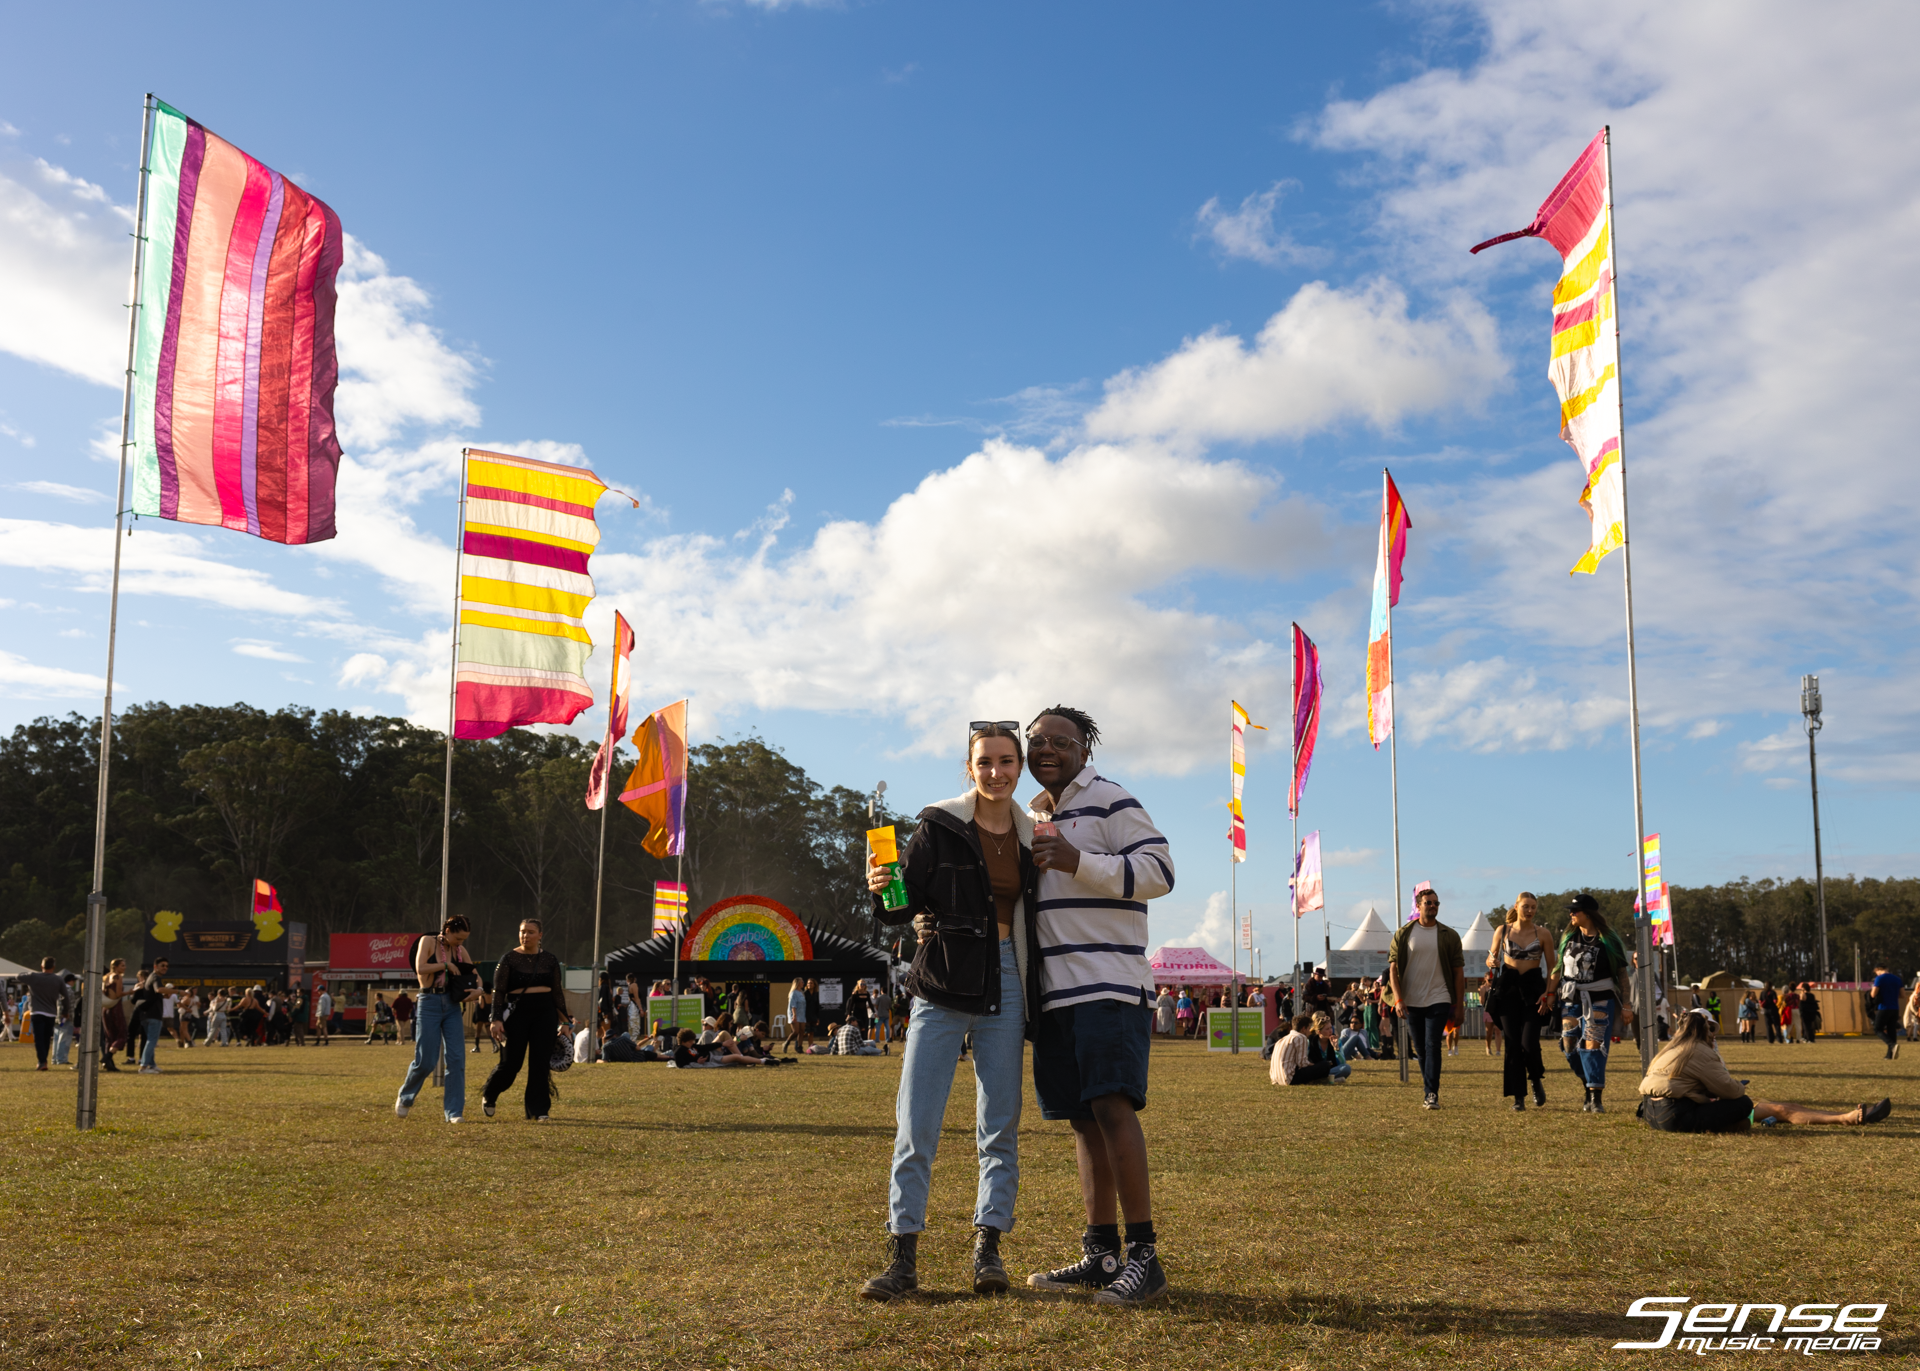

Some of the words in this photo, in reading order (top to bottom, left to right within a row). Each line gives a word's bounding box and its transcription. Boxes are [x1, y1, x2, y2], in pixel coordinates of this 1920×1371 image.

[369, 937, 392, 951] Real
[394, 934, 409, 947] OG
[716, 926, 772, 947] Rainbow
[370, 949, 404, 963] Burgers
[1151, 962, 1218, 970] GLITORIS
